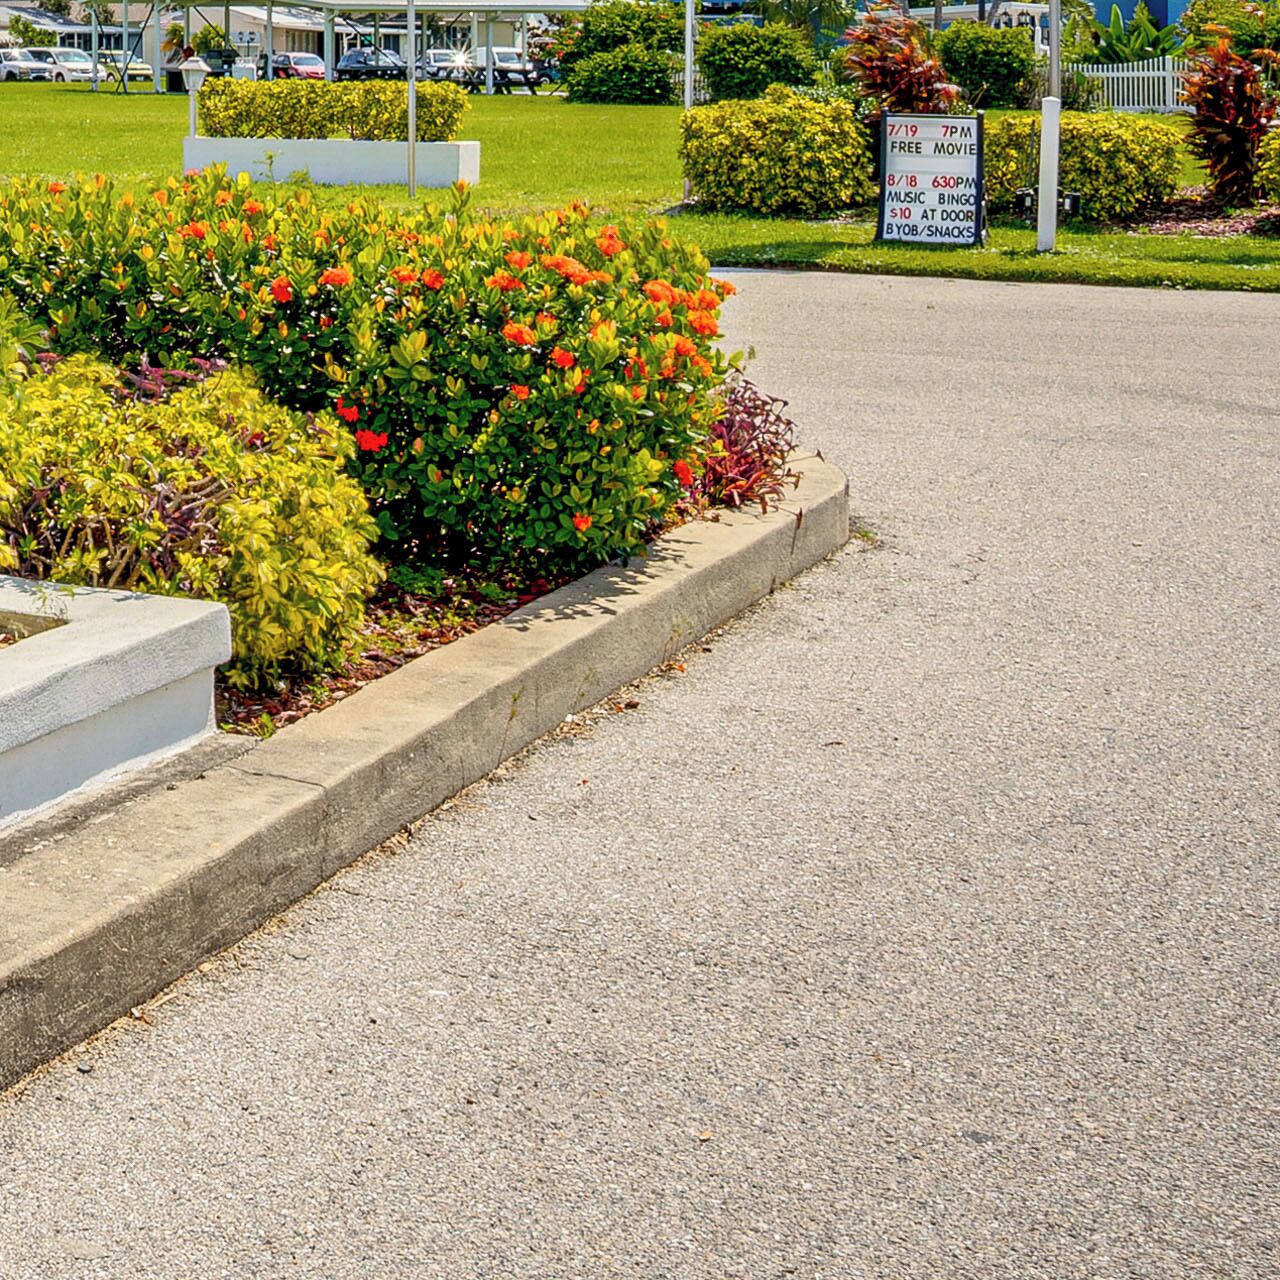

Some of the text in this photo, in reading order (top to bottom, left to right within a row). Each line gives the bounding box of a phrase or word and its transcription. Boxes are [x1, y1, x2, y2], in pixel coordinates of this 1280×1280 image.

[888, 124, 972, 138] 7/19 7PM
[890, 141, 976, 155] FREE MOVIE
[887, 174, 977, 189] 8/18 630PM
[886, 191, 976, 206] MUSIC BINGO
[921, 208, 937, 221] AT
[941, 210, 974, 222] DOOR
[886, 223, 975, 238] BYOB/SNACKS
